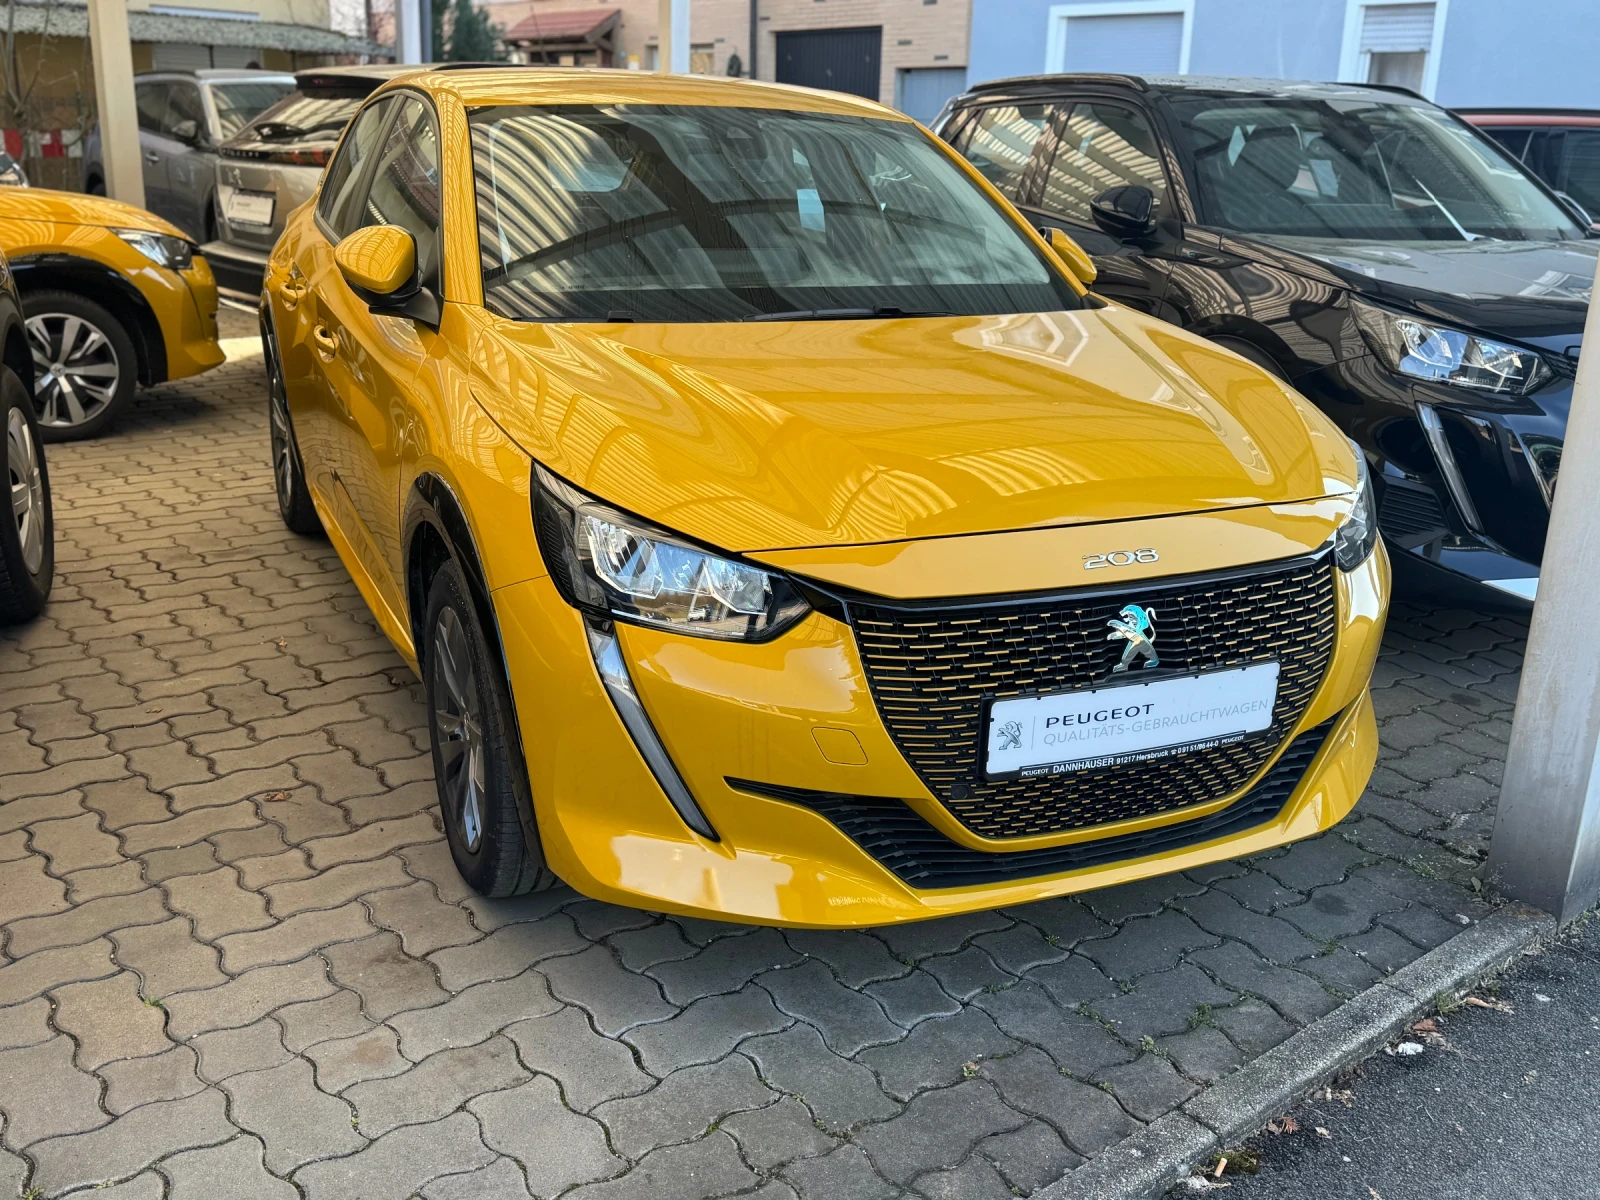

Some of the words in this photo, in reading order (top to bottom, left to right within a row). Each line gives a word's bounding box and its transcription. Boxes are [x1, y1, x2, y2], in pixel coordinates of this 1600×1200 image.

[1082, 548, 1159, 570] 208
[1043, 699, 1269, 745] QUALITÄTS-GEBRAUCHTWAGEN
[1045, 703, 1155, 728] PEUGEOT
[1021, 768, 1049, 777] PEUGEOT
[1116, 756, 1136, 765] 91217
[1136, 750, 1169, 761] Hersbruck
[1221, 734, 1245, 745] PEUGEOT
